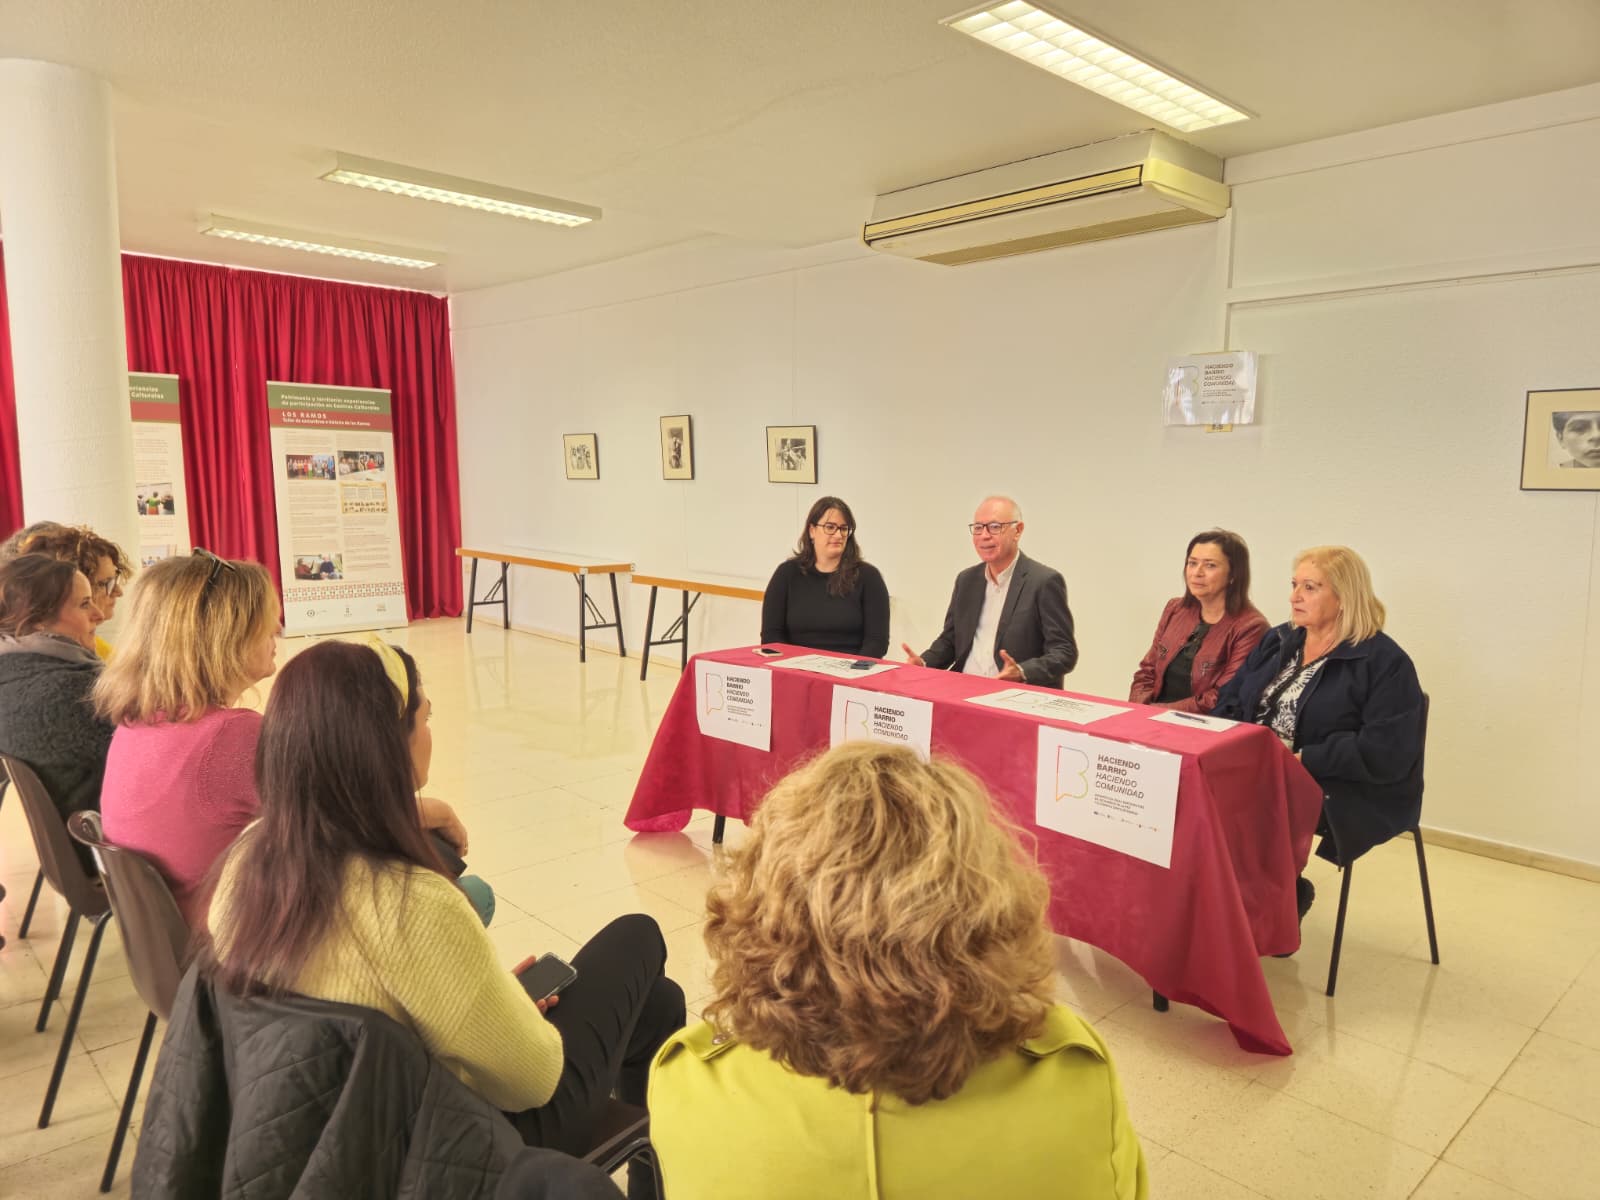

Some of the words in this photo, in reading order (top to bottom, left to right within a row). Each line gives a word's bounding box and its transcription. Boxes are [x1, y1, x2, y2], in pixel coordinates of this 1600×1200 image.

[726, 675, 751, 684] HACIENDO
[873, 713, 896, 723] BARRIO
[874, 706, 905, 717] HACIENDO
[873, 721, 904, 732] HACIENDO
[873, 728, 909, 741] COMUNIDAD
[1097, 754, 1141, 770] HACIENDO
[1096, 763, 1128, 776] BARRIO
[1095, 772, 1138, 788] HACIENDO
[1095, 781, 1145, 799] COMUNIDAD
